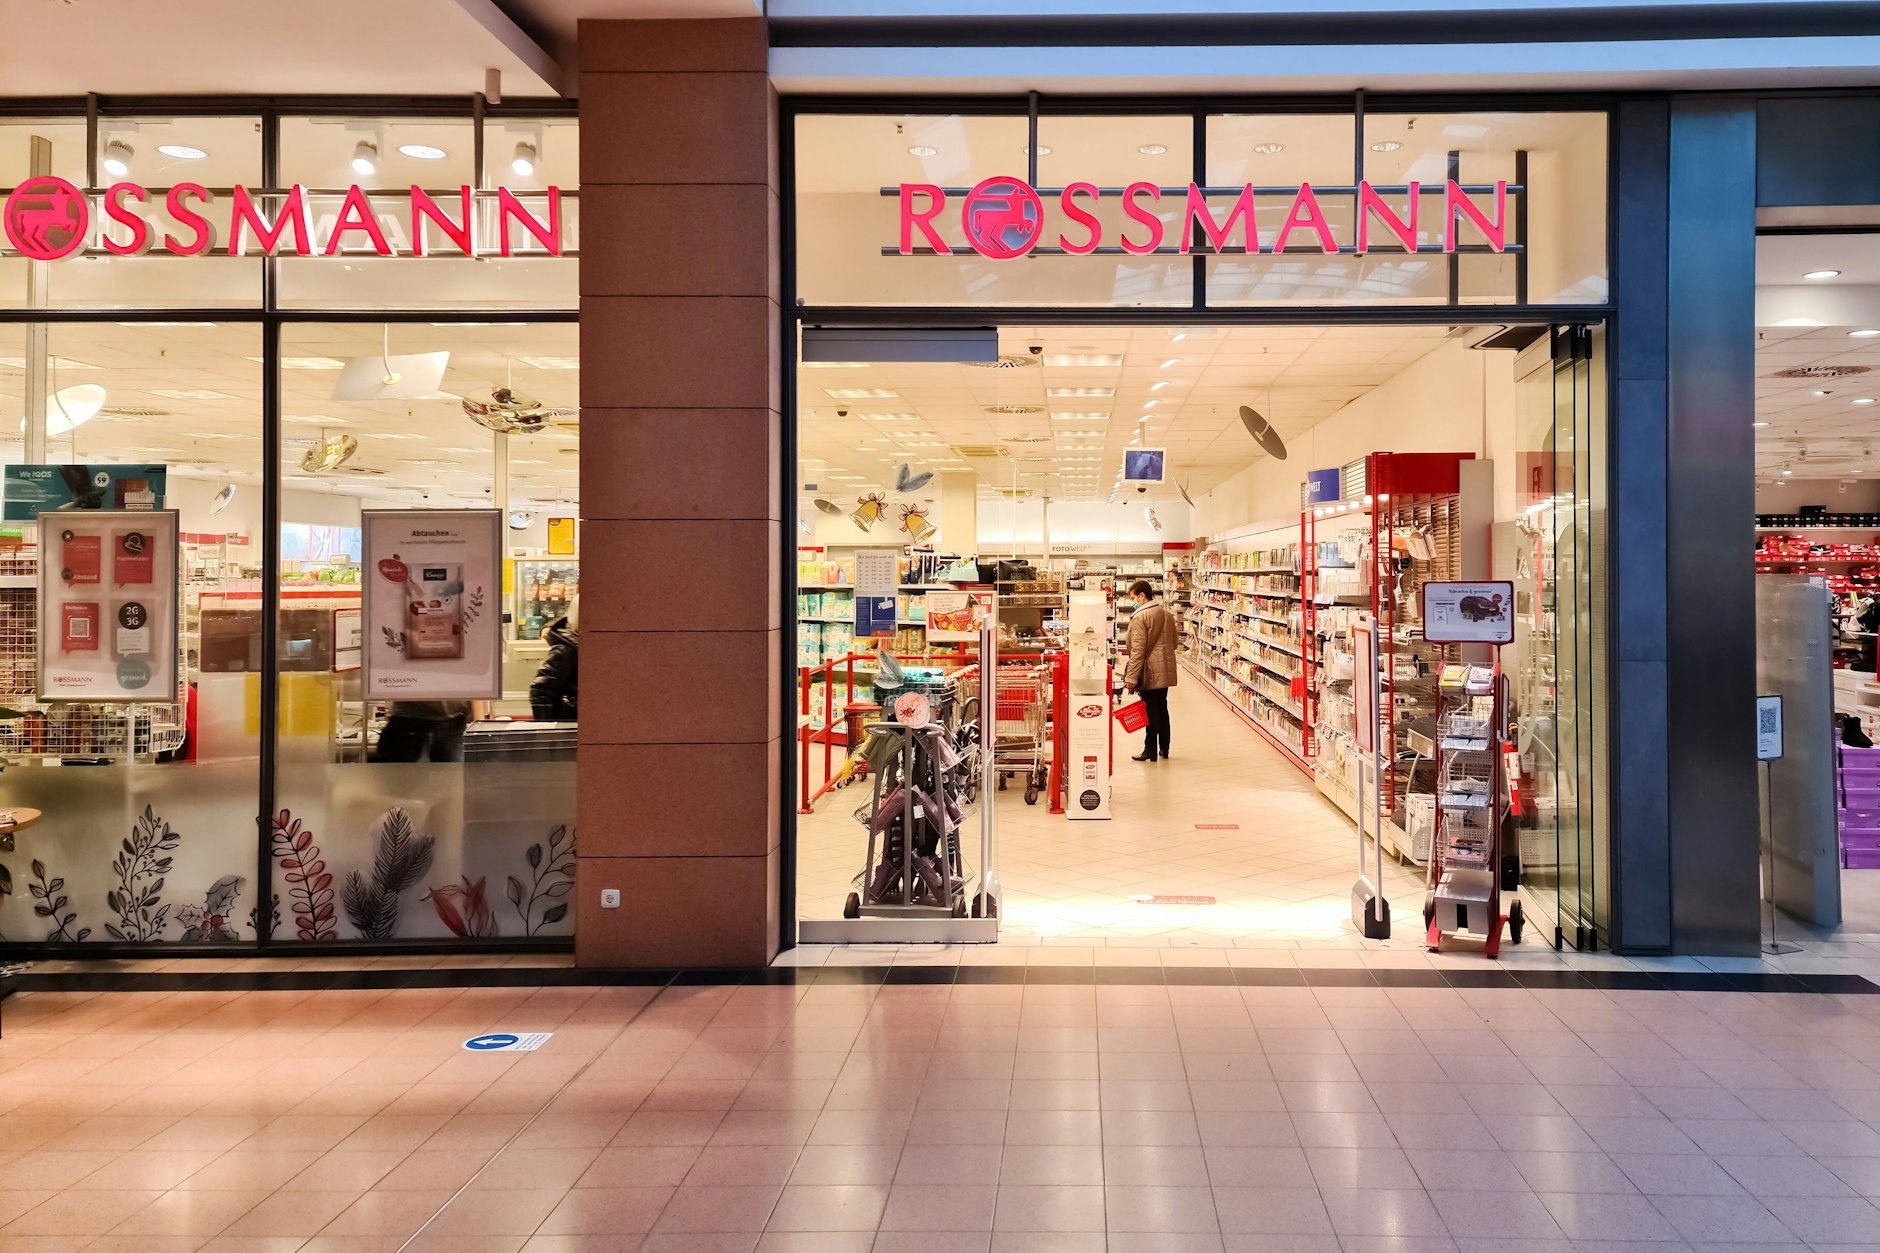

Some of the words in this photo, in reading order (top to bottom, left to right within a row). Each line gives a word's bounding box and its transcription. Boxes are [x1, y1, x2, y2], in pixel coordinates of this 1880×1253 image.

[899, 175, 1507, 260] ROSSMANN
[32, 470, 52, 478] IQOS
[126, 606, 139, 615] 2G
[126, 617, 139, 626] 3G
